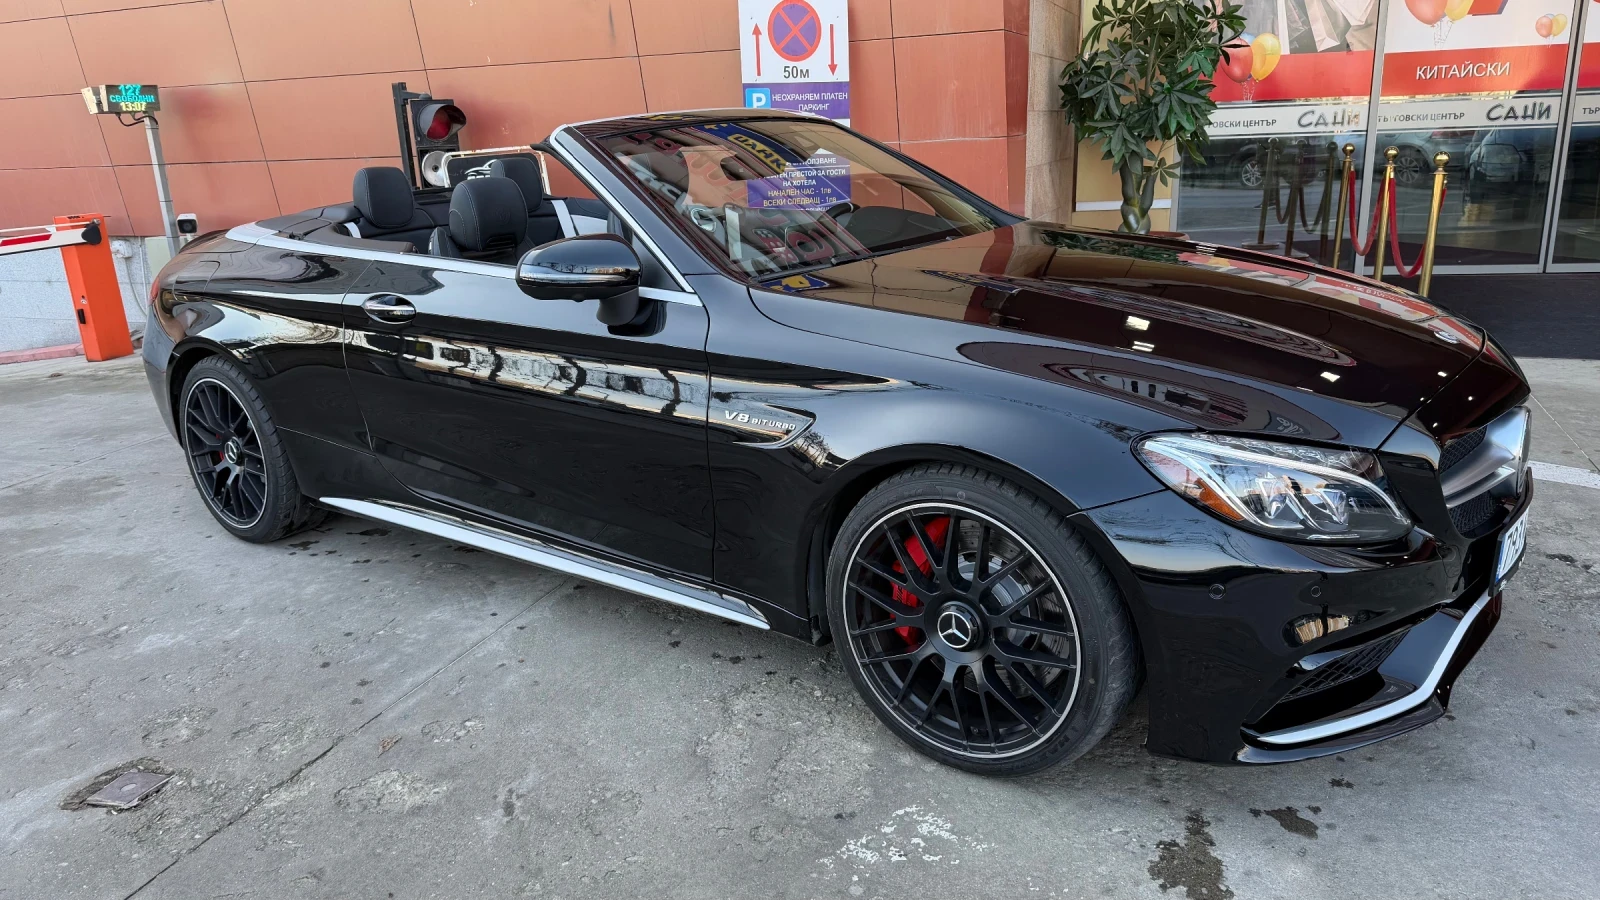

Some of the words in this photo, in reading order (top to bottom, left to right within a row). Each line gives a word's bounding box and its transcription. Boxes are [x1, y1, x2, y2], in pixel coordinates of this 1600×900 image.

[1416, 61, 1510, 80] КИТАЙСКИ
[118, 84, 142, 96] 127
[109, 95, 155, 103] СВОБОДНИ
[772, 93, 820, 102] НЕОХРАНЯЕМ
[821, 92, 848, 100] ПЛАТЕН
[119, 102, 147, 111] 13:07
[1430, 112, 1465, 122] ЦЕНТЪР
[1242, 119, 1277, 128] ЦЕНТЪР
[788, 168, 817, 177] ПРЕСТОЙ
[767, 189, 799, 197] НАЧАЛЕН
[763, 198, 786, 207] ВСЕКИ
[787, 197, 821, 206] СЛЕДВАЩ
[724, 410, 750, 423] V8
[751, 417, 797, 430] BITURBO
